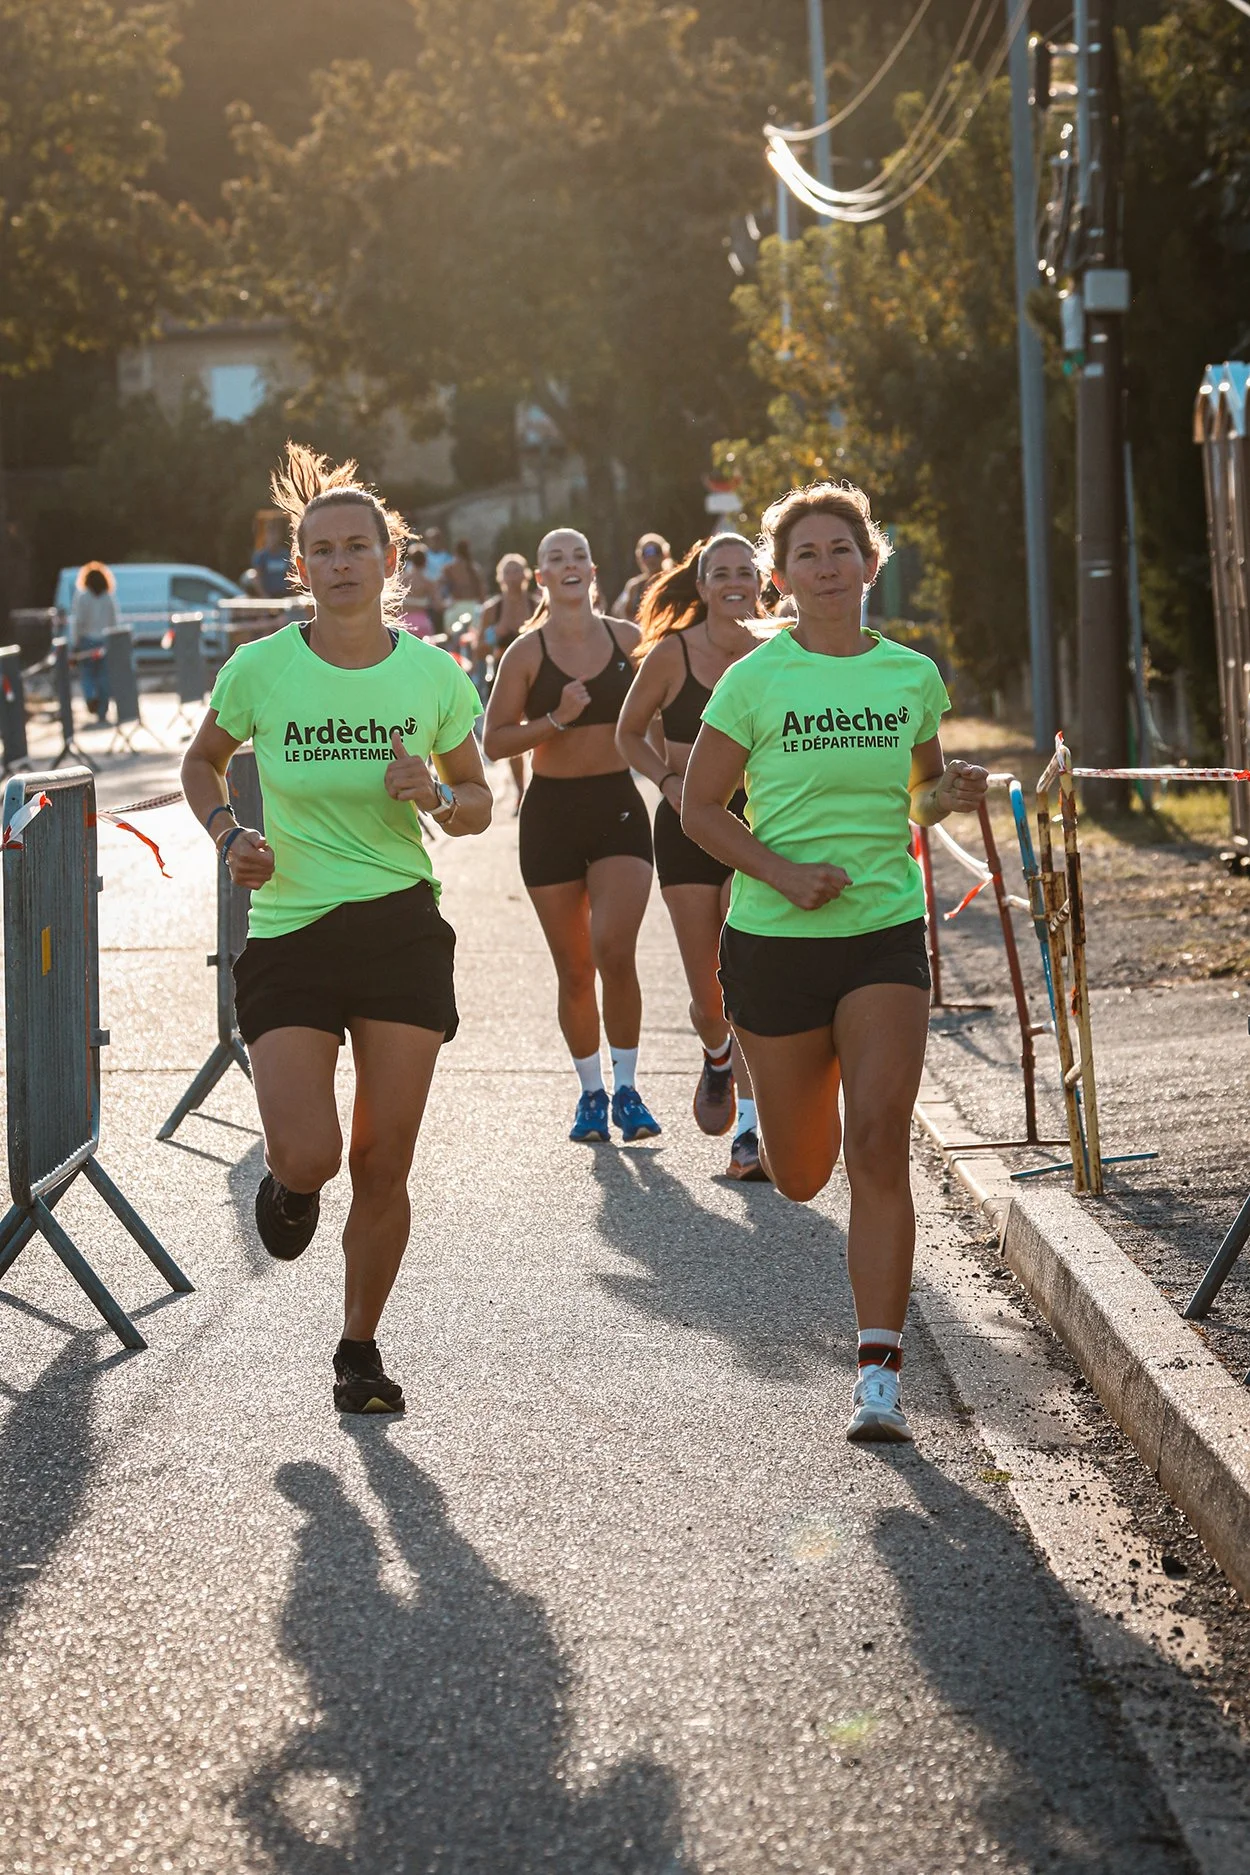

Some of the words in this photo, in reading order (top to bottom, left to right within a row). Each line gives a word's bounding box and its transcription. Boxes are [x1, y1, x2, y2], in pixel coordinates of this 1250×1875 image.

[782, 707, 898, 737] Ardèche
[783, 740, 799, 753] LE
[802, 735, 900, 752] DÉPARTEMENT
[285, 750, 300, 762] LE
[303, 747, 398, 762] DÉPARTEMEN
